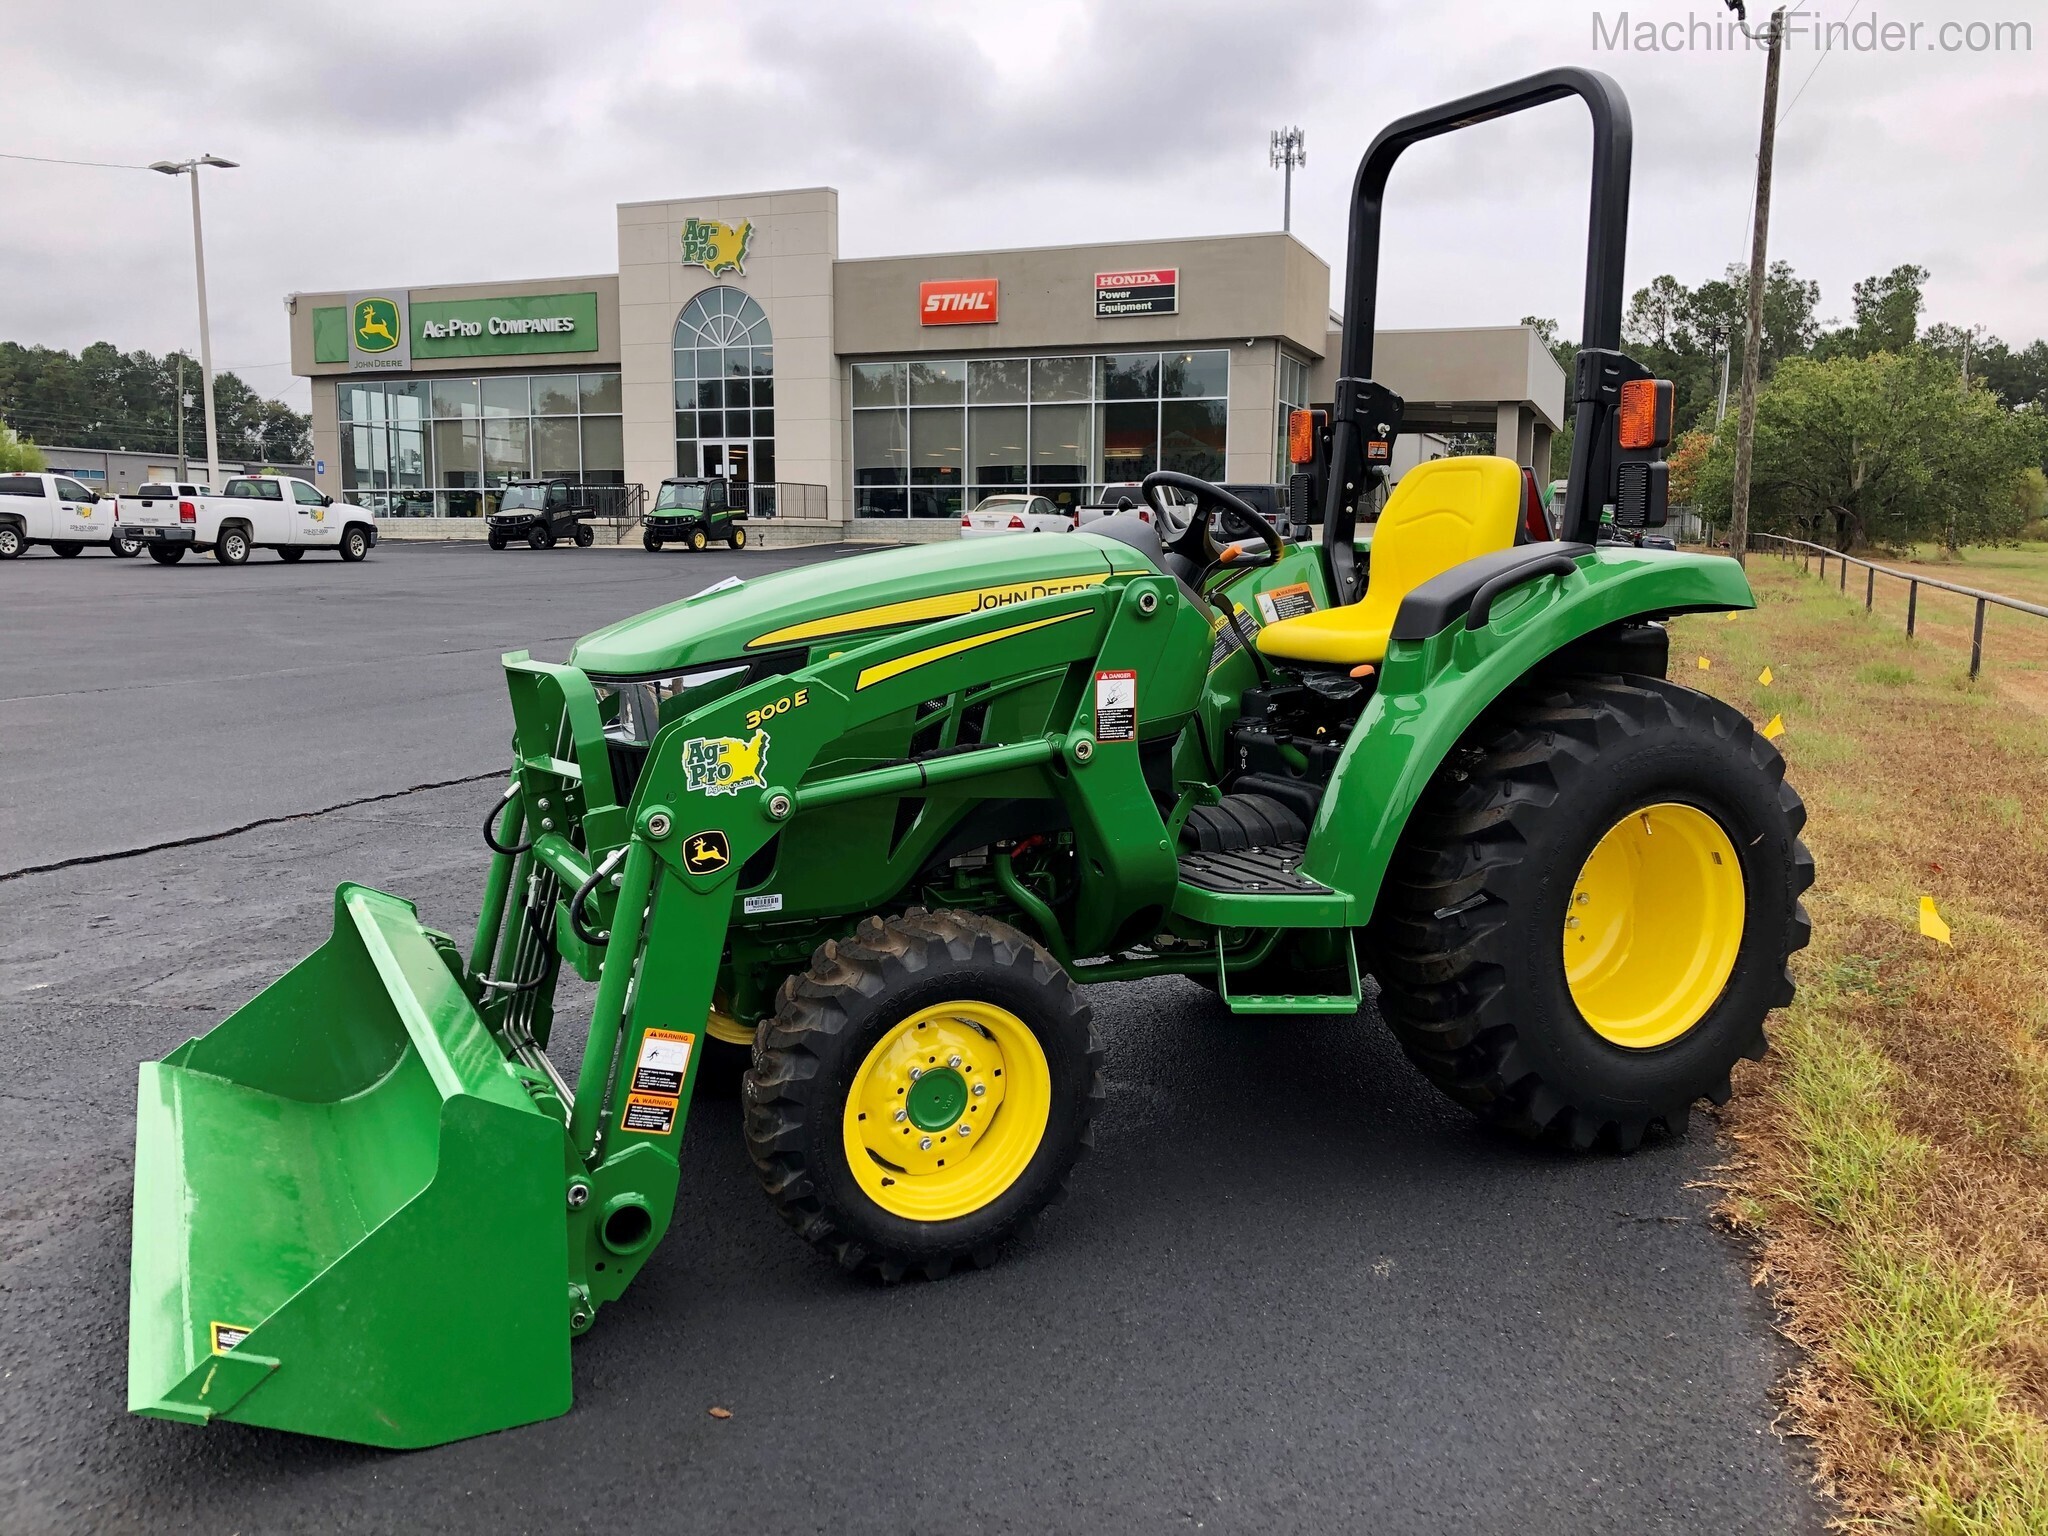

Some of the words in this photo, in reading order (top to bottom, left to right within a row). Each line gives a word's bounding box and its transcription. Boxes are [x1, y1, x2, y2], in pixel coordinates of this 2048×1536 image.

[683, 219, 718, 245] Ag-
[683, 242, 718, 262] Pro
[1098, 274, 1161, 287] HONDA
[924, 291, 990, 312] STIHL
[1099, 290, 1131, 299] Power
[1099, 302, 1153, 313] Equipment
[354, 360, 374, 369] JOHN
[374, 359, 403, 368] DEERE
[971, 591, 1027, 613] JOHN
[746, 697, 792, 730] 300
[794, 688, 809, 708] E
[688, 742, 728, 766] Ag-
[689, 763, 732, 787] Pro
[658, 1030, 689, 1041] WARNING
[642, 1098, 673, 1107] WARNING
